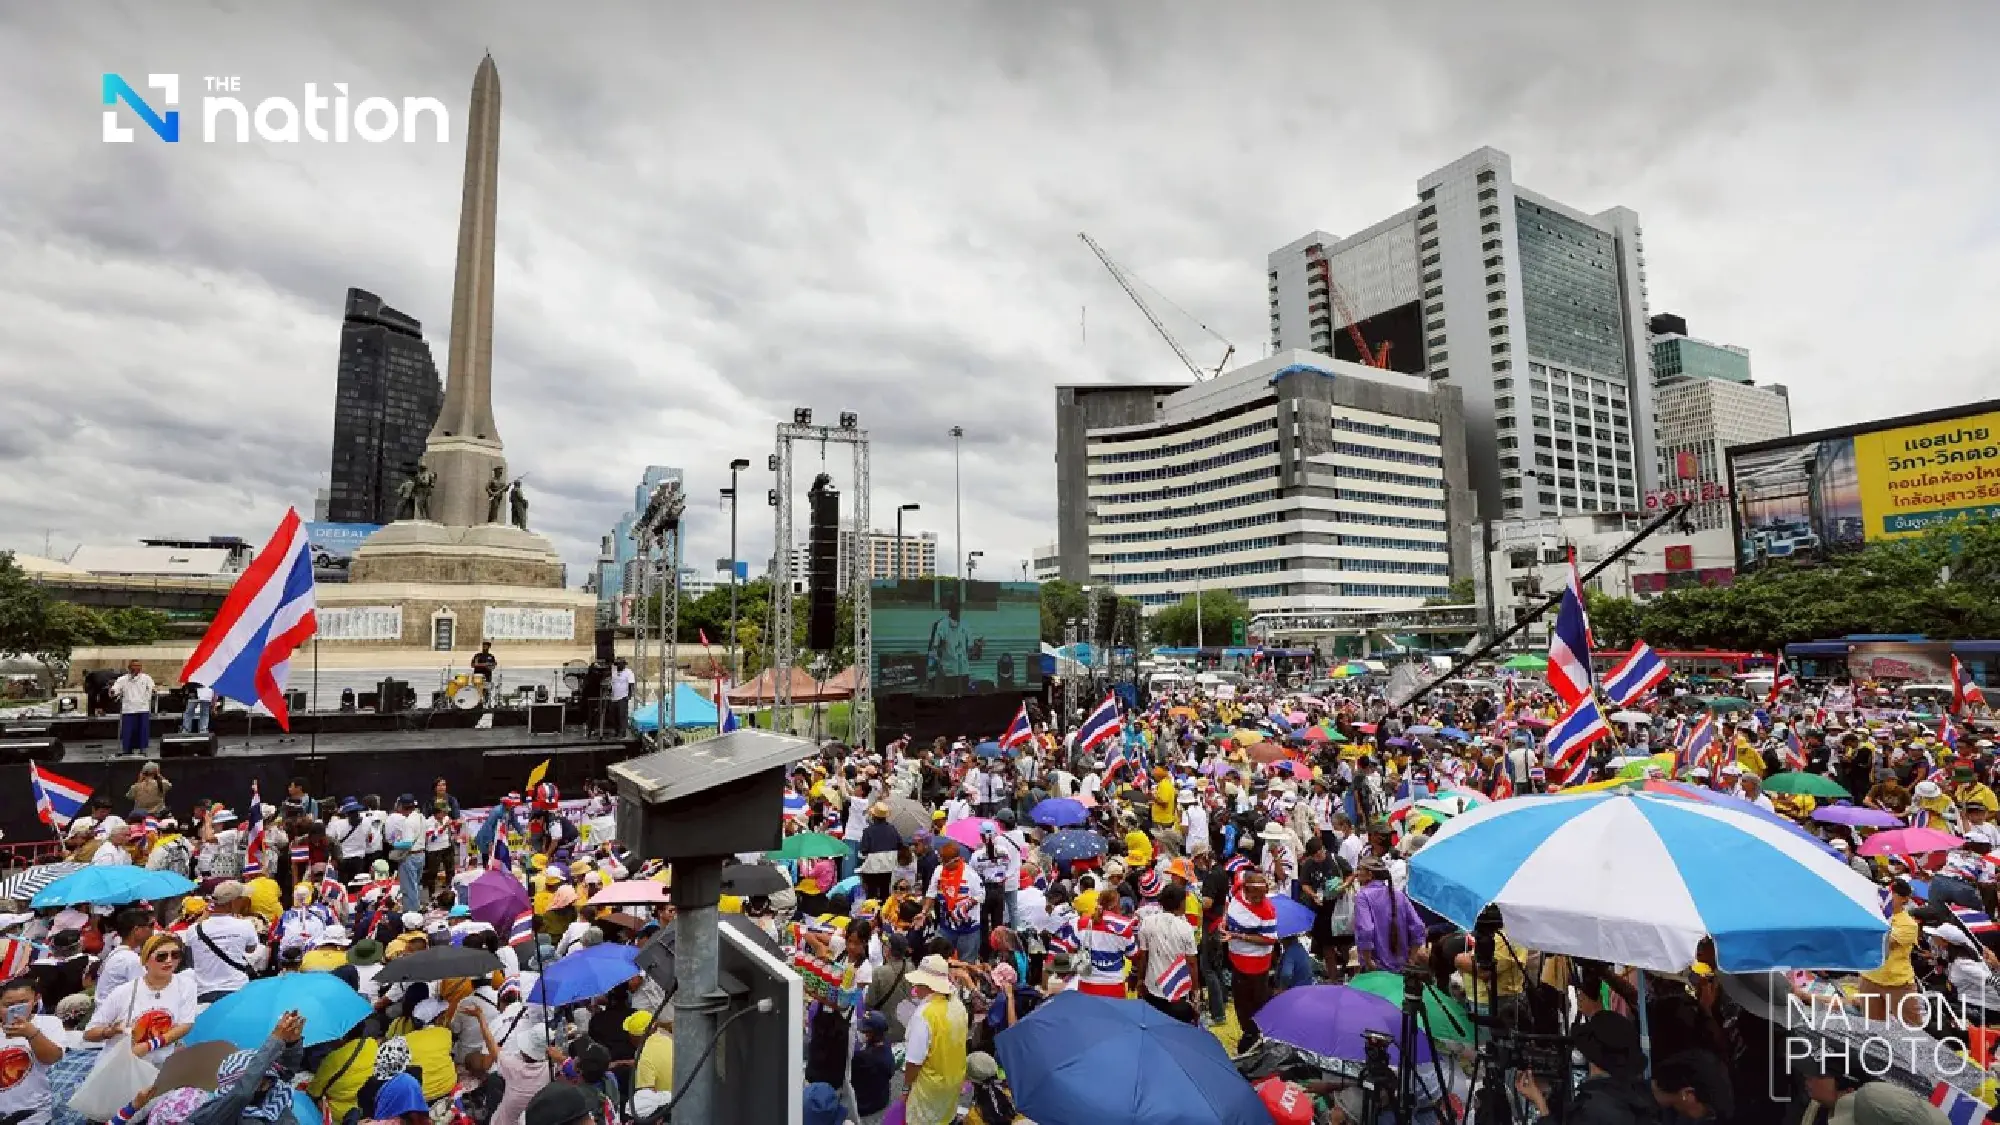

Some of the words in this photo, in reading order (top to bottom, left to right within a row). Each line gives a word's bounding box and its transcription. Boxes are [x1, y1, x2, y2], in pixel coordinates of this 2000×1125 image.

[1904, 428, 1989, 451] แอสปาย
[1887, 447, 2000, 472] วิภา-วิคตอ
[316, 528, 363, 538] DEEPAL
